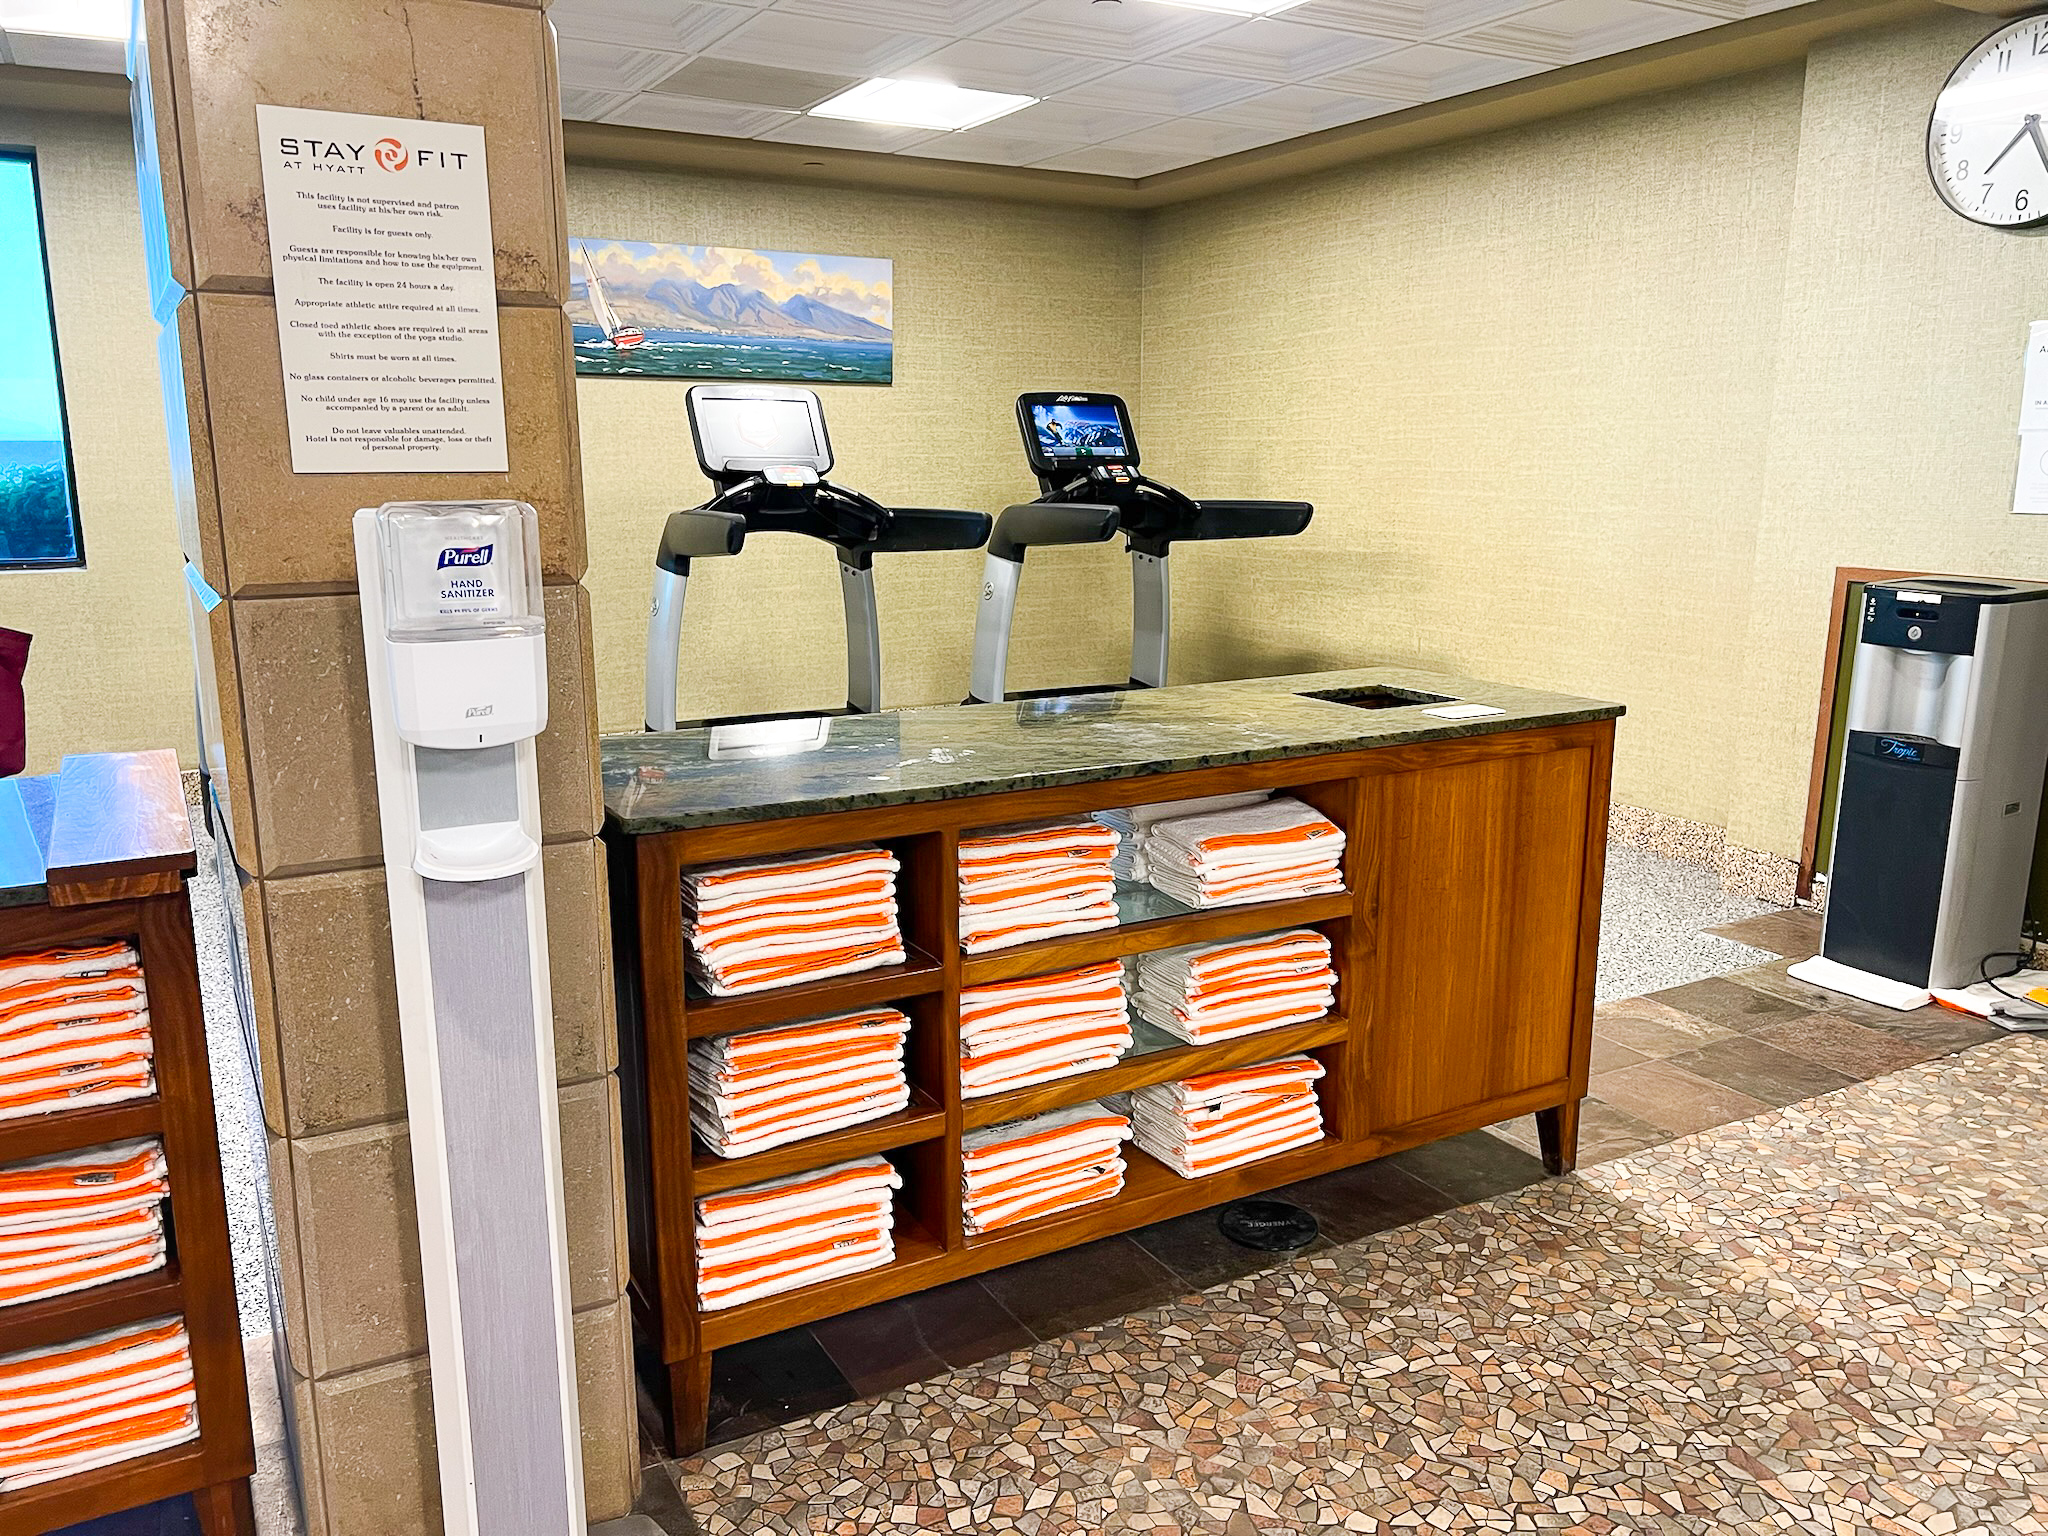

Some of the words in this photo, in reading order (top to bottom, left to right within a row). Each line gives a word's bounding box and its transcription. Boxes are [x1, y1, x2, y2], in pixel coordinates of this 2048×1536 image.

[1998, 50, 2012, 72] 11
[1950, 124, 1962, 144] 9
[280, 137, 365, 161] STAY
[417, 149, 468, 170] FIT
[283, 160, 302, 169] AT
[312, 162, 365, 174] HYATT
[1956, 159, 1969, 180] 8
[295, 191, 314, 199] This
[316, 192, 345, 203] facility
[1981, 182, 1994, 204] 7
[2014, 189, 2029, 211] 6
[338, 203, 366, 213] facility
[332, 225, 362, 235] Facility
[289, 244, 318, 253] Guests
[336, 249, 382, 257] responsible
[397, 250, 430, 261] knowing
[282, 253, 316, 262] physical
[319, 254, 363, 264] limitations
[335, 278, 363, 288] facility
[294, 298, 342, 308] Appropriate
[345, 301, 375, 309] athletic
[289, 320, 318, 328] Closed
[341, 322, 371, 330] athletic
[418, 333, 436, 342] yoga
[303, 373, 324, 381] glass
[418, 375, 456, 384] beverages
[438, 396, 464, 405] facility
[325, 403, 378, 412] accompanied
[380, 404, 390, 412] by
[354, 435, 399, 443] responsible
[371, 443, 405, 451] personal
[444, 548, 489, 565] Purell
[450, 580, 482, 588] HAND
[441, 588, 494, 598] SANITIZER
[1880, 738, 1918, 758] Tropic
